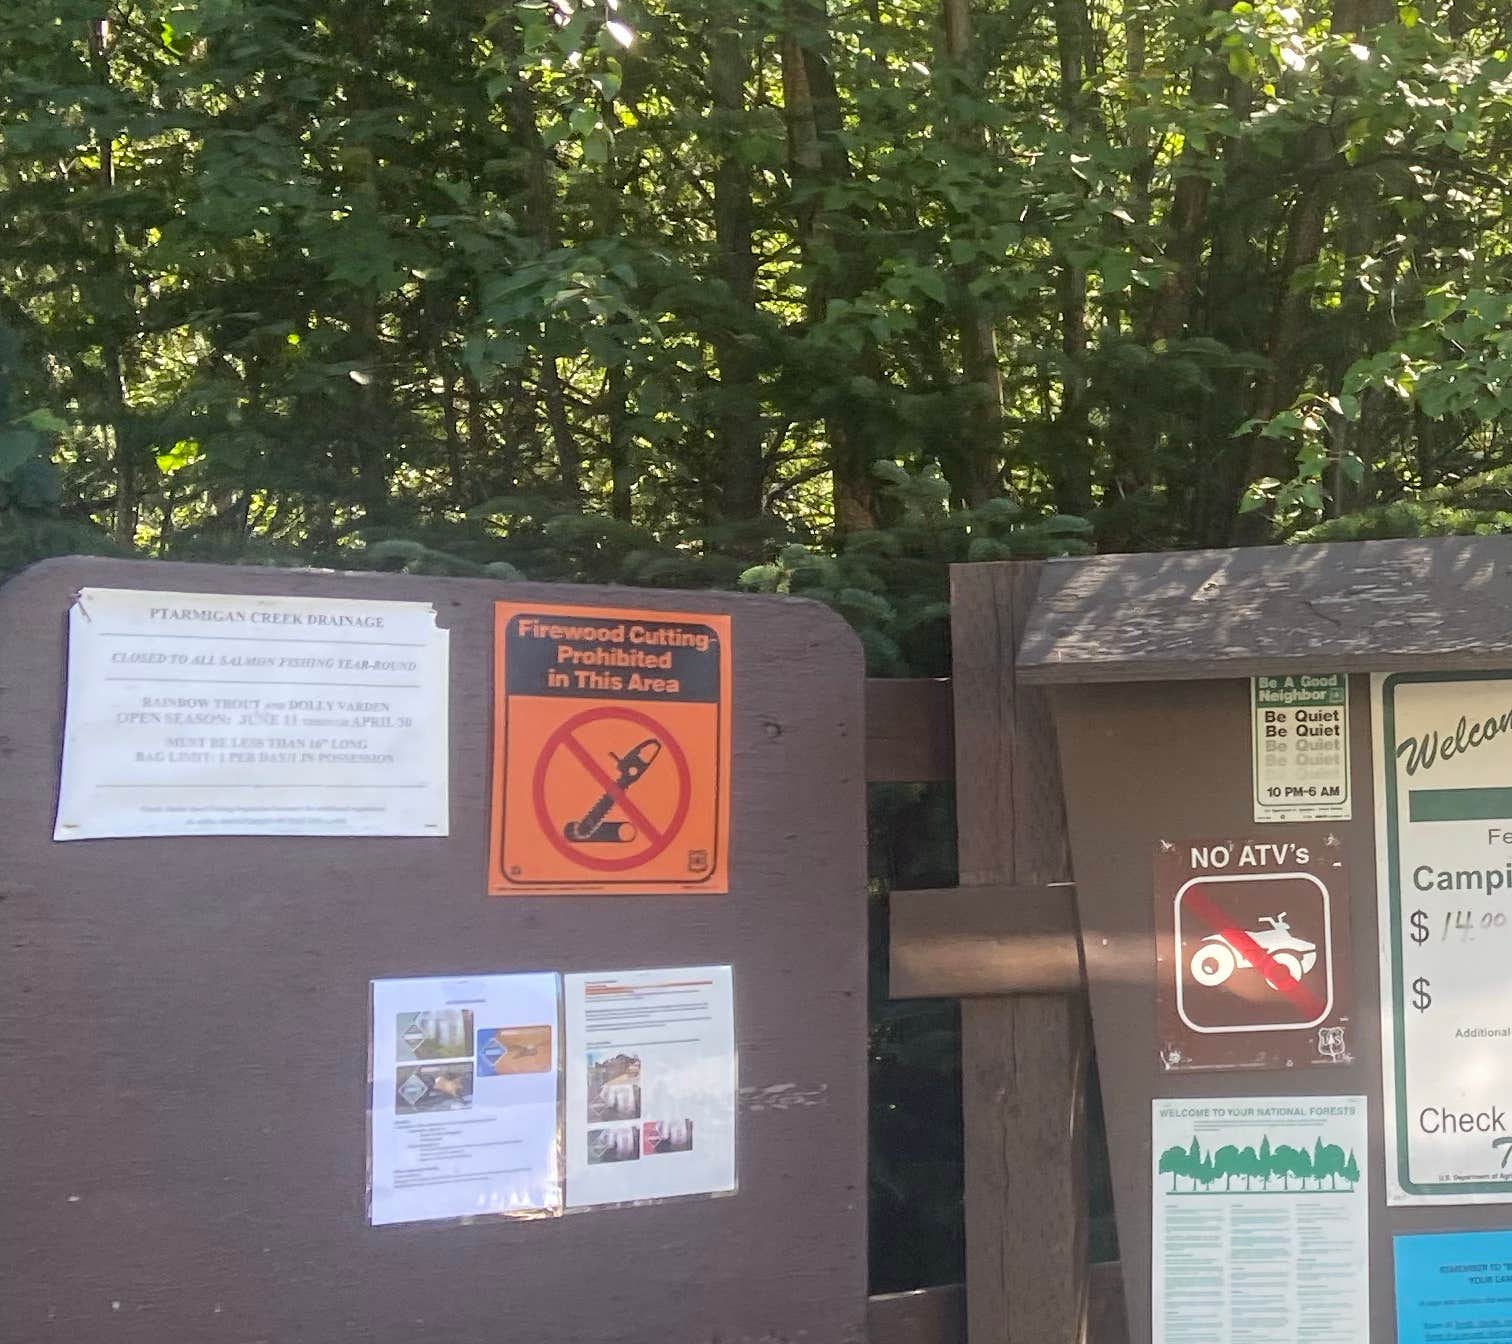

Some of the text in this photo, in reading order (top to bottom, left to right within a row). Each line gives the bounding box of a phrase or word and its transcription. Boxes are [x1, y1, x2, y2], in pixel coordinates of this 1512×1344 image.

[150, 608, 384, 628] PTARMIGAN CREEK DRAINAGE
[518, 619, 709, 652] Firewood Cutting
[111, 652, 167, 664] CLOSED
[171, 654, 189, 665] TO
[278, 657, 335, 669] FISHING
[557, 645, 673, 669] Prohibited
[547, 669, 680, 693] in This Area
[1259, 674, 1338, 689] Be A Good
[1258, 688, 1327, 704] Neighbor
[1265, 709, 1340, 723] Be Quiet
[1265, 724, 1340, 737] Be Quiet
[1265, 738, 1340, 752] Be Quiet
[1267, 787, 1281, 797] 10
[1320, 786, 1340, 797] AM
[1190, 843, 1310, 868] NO ATV's
[1410, 909, 1430, 947] $
[1412, 976, 1432, 1014] $
[1455, 1027, 1511, 1039] Additional
[1160, 1108, 1210, 1118] WELCOME
[1228, 1107, 1255, 1117] YOUR
[1257, 1106, 1306, 1117] NATIONAL
[1418, 1104, 1506, 1135] Check
